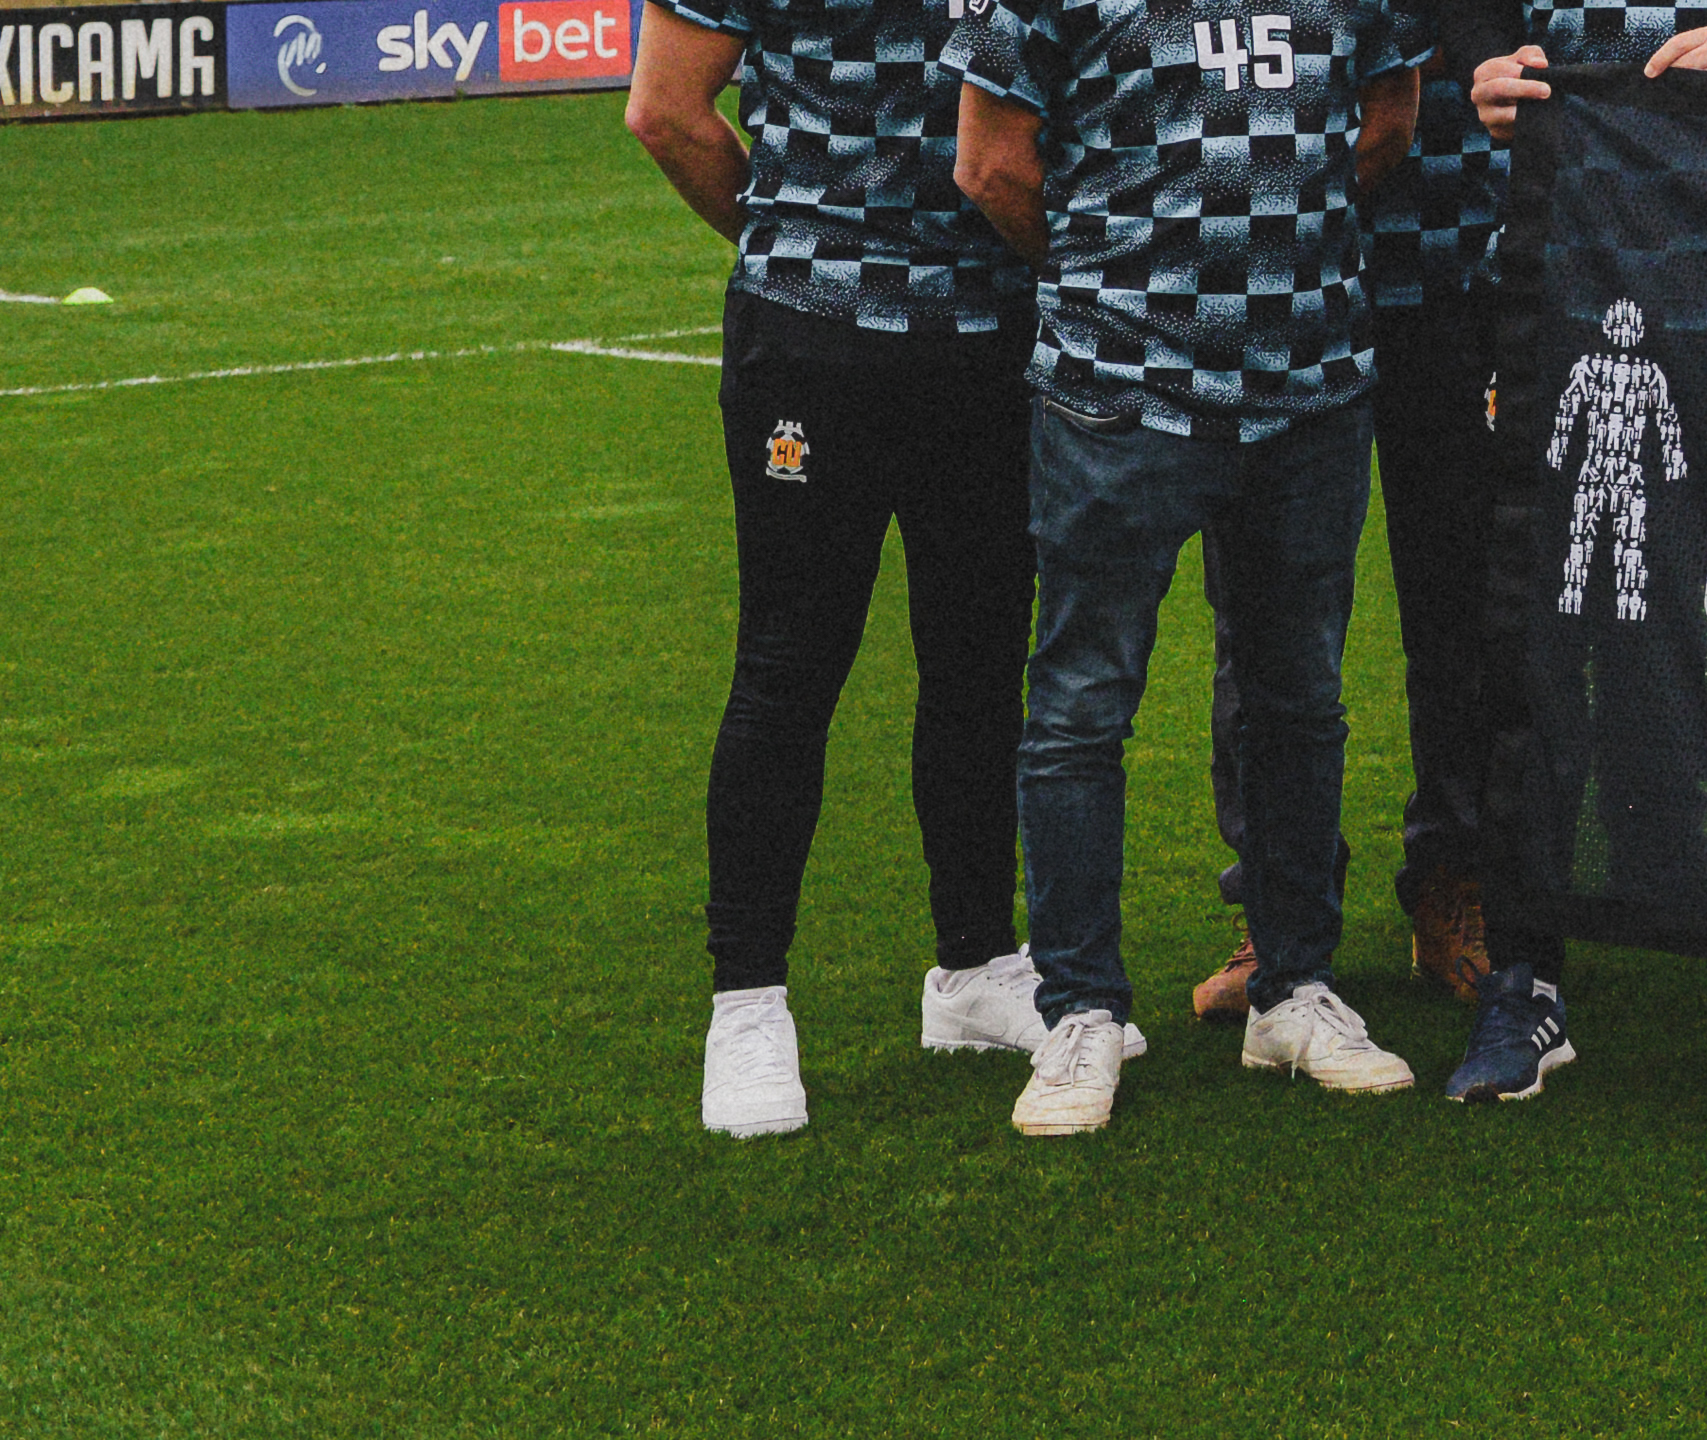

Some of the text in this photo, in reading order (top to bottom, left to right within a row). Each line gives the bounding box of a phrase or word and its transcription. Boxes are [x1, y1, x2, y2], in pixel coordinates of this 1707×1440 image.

[376, 8, 617, 82] sky bet
[1193, 14, 1295, 92] 45
